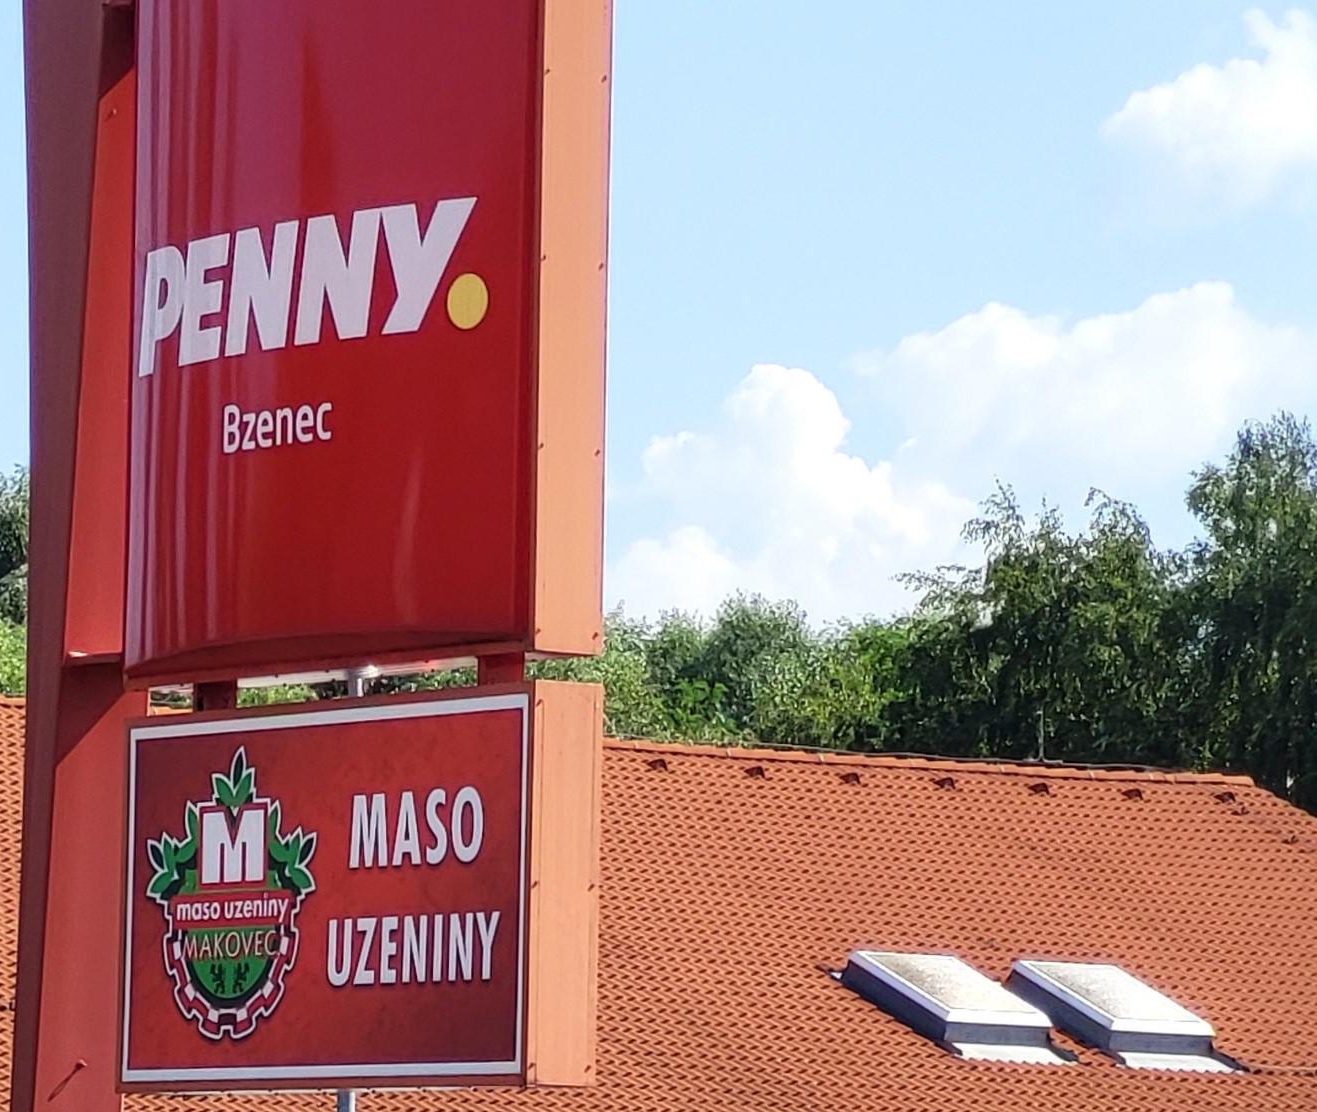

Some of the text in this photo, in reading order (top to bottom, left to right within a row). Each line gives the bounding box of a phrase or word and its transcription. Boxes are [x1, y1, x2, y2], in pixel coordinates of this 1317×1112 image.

[223, 402, 333, 453] Bzenec
[200, 809, 265, 884] M
[349, 786, 484, 869] MASO
[176, 894, 289, 925] maso uzeniny
[183, 929, 277, 960] MAKOVEC
[326, 911, 501, 987] UZENINY
